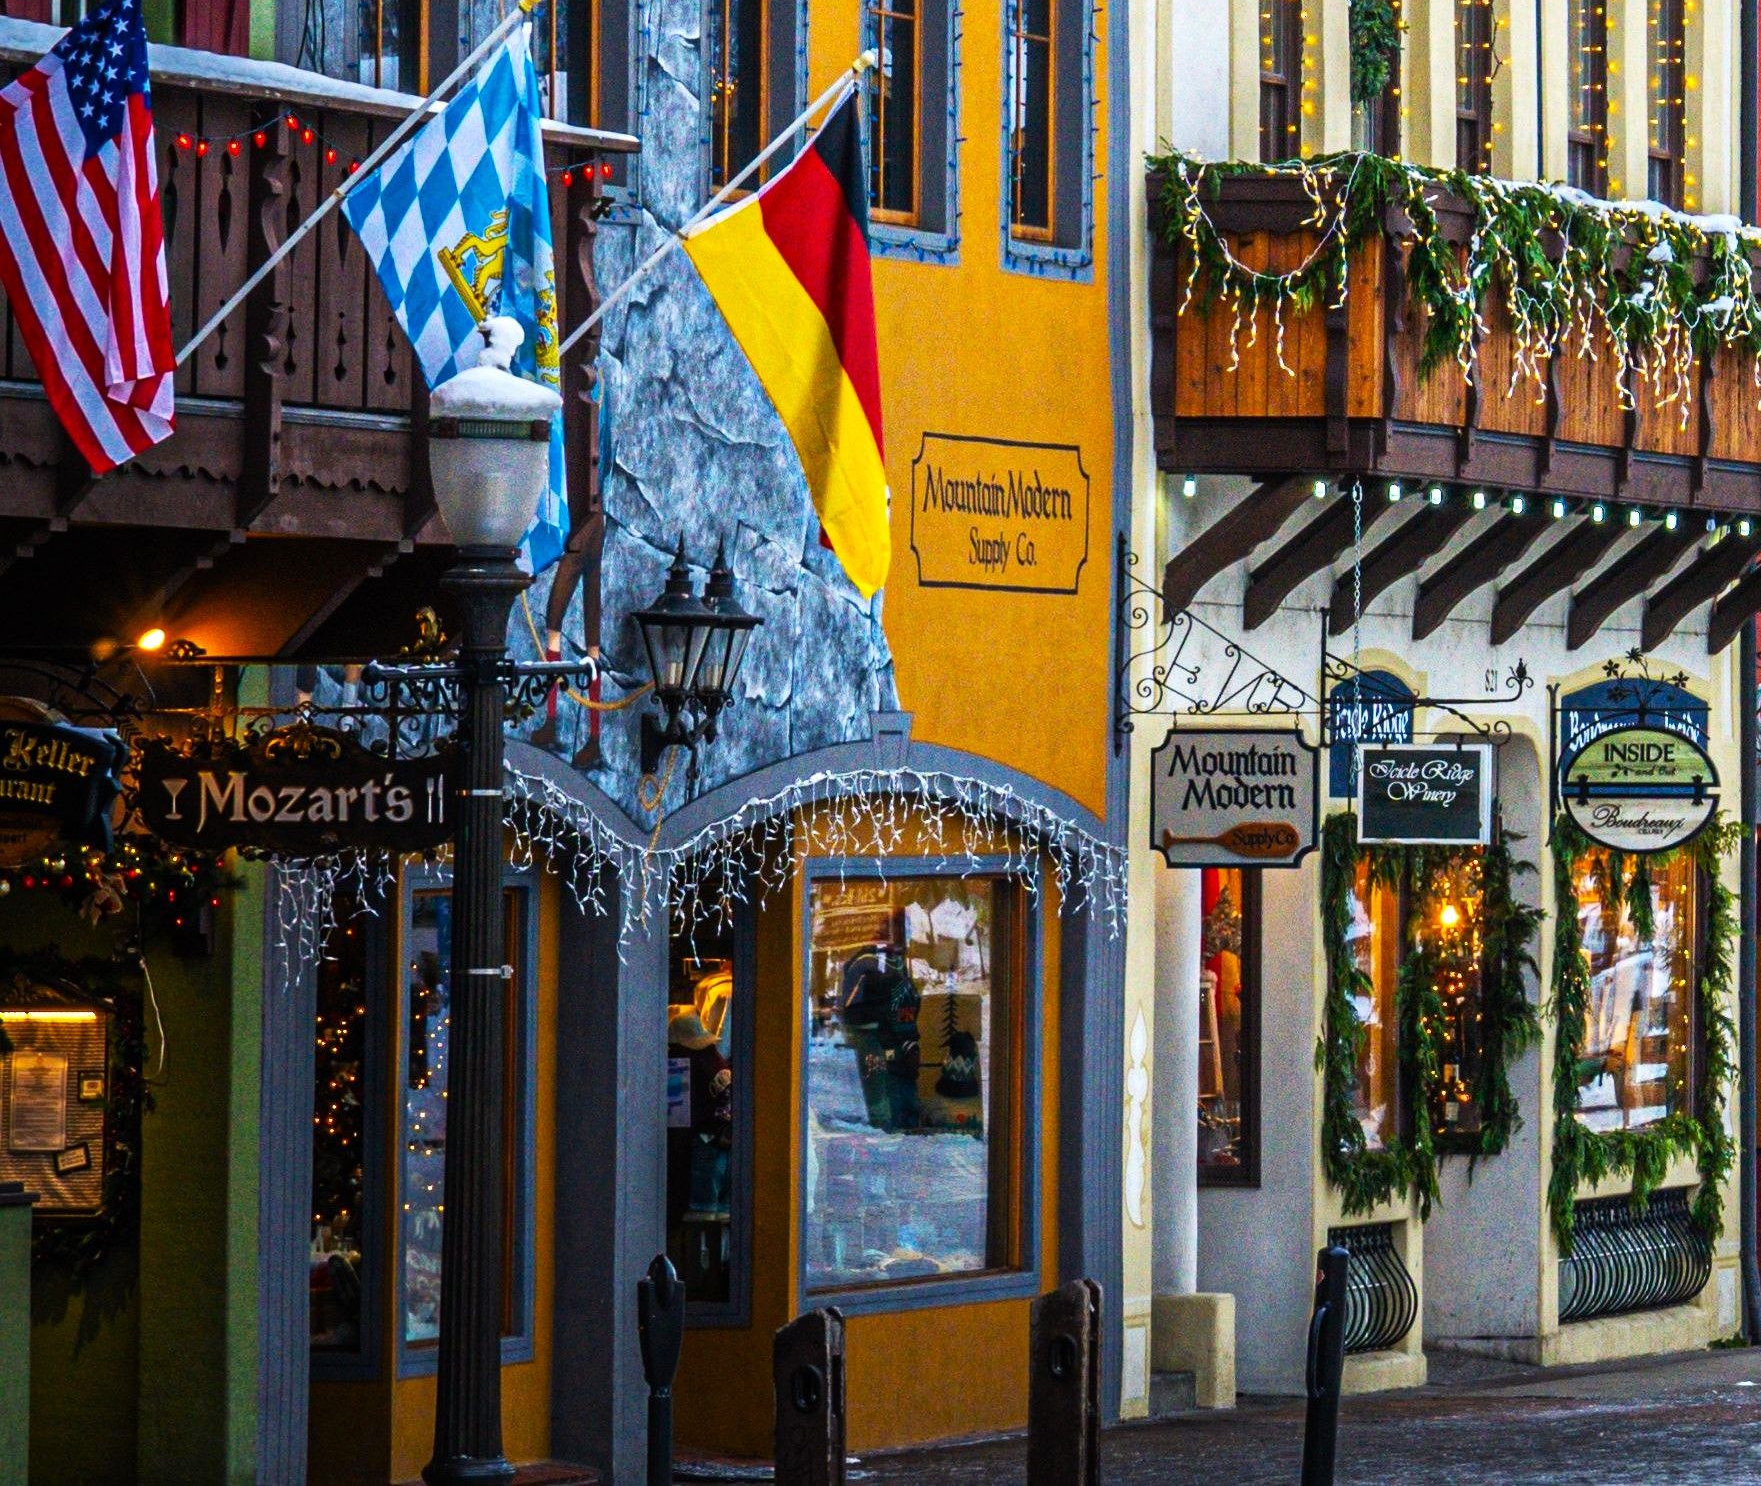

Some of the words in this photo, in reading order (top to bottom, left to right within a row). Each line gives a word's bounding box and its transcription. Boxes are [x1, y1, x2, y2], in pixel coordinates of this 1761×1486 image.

[922, 464, 1005, 516] Mountain
[1006, 469, 1072, 520] Modern
[969, 526, 1011, 574] Supply
[1016, 532, 1037, 566] Co.
[3, 728, 95, 777] Keller
[1168, 744, 1298, 777] Mountain
[1604, 743, 1675, 763] INSIDE
[1369, 760, 1420, 780] Icicle
[1421, 760, 1475, 787] Ridge
[196, 770, 414, 834] Mozart's
[1181, 777, 1297, 811] Modern
[1387, 781, 1457, 808] Winery
[1232, 828, 1275, 849] Supply
[1591, 803, 1686, 840] Boudreaux
